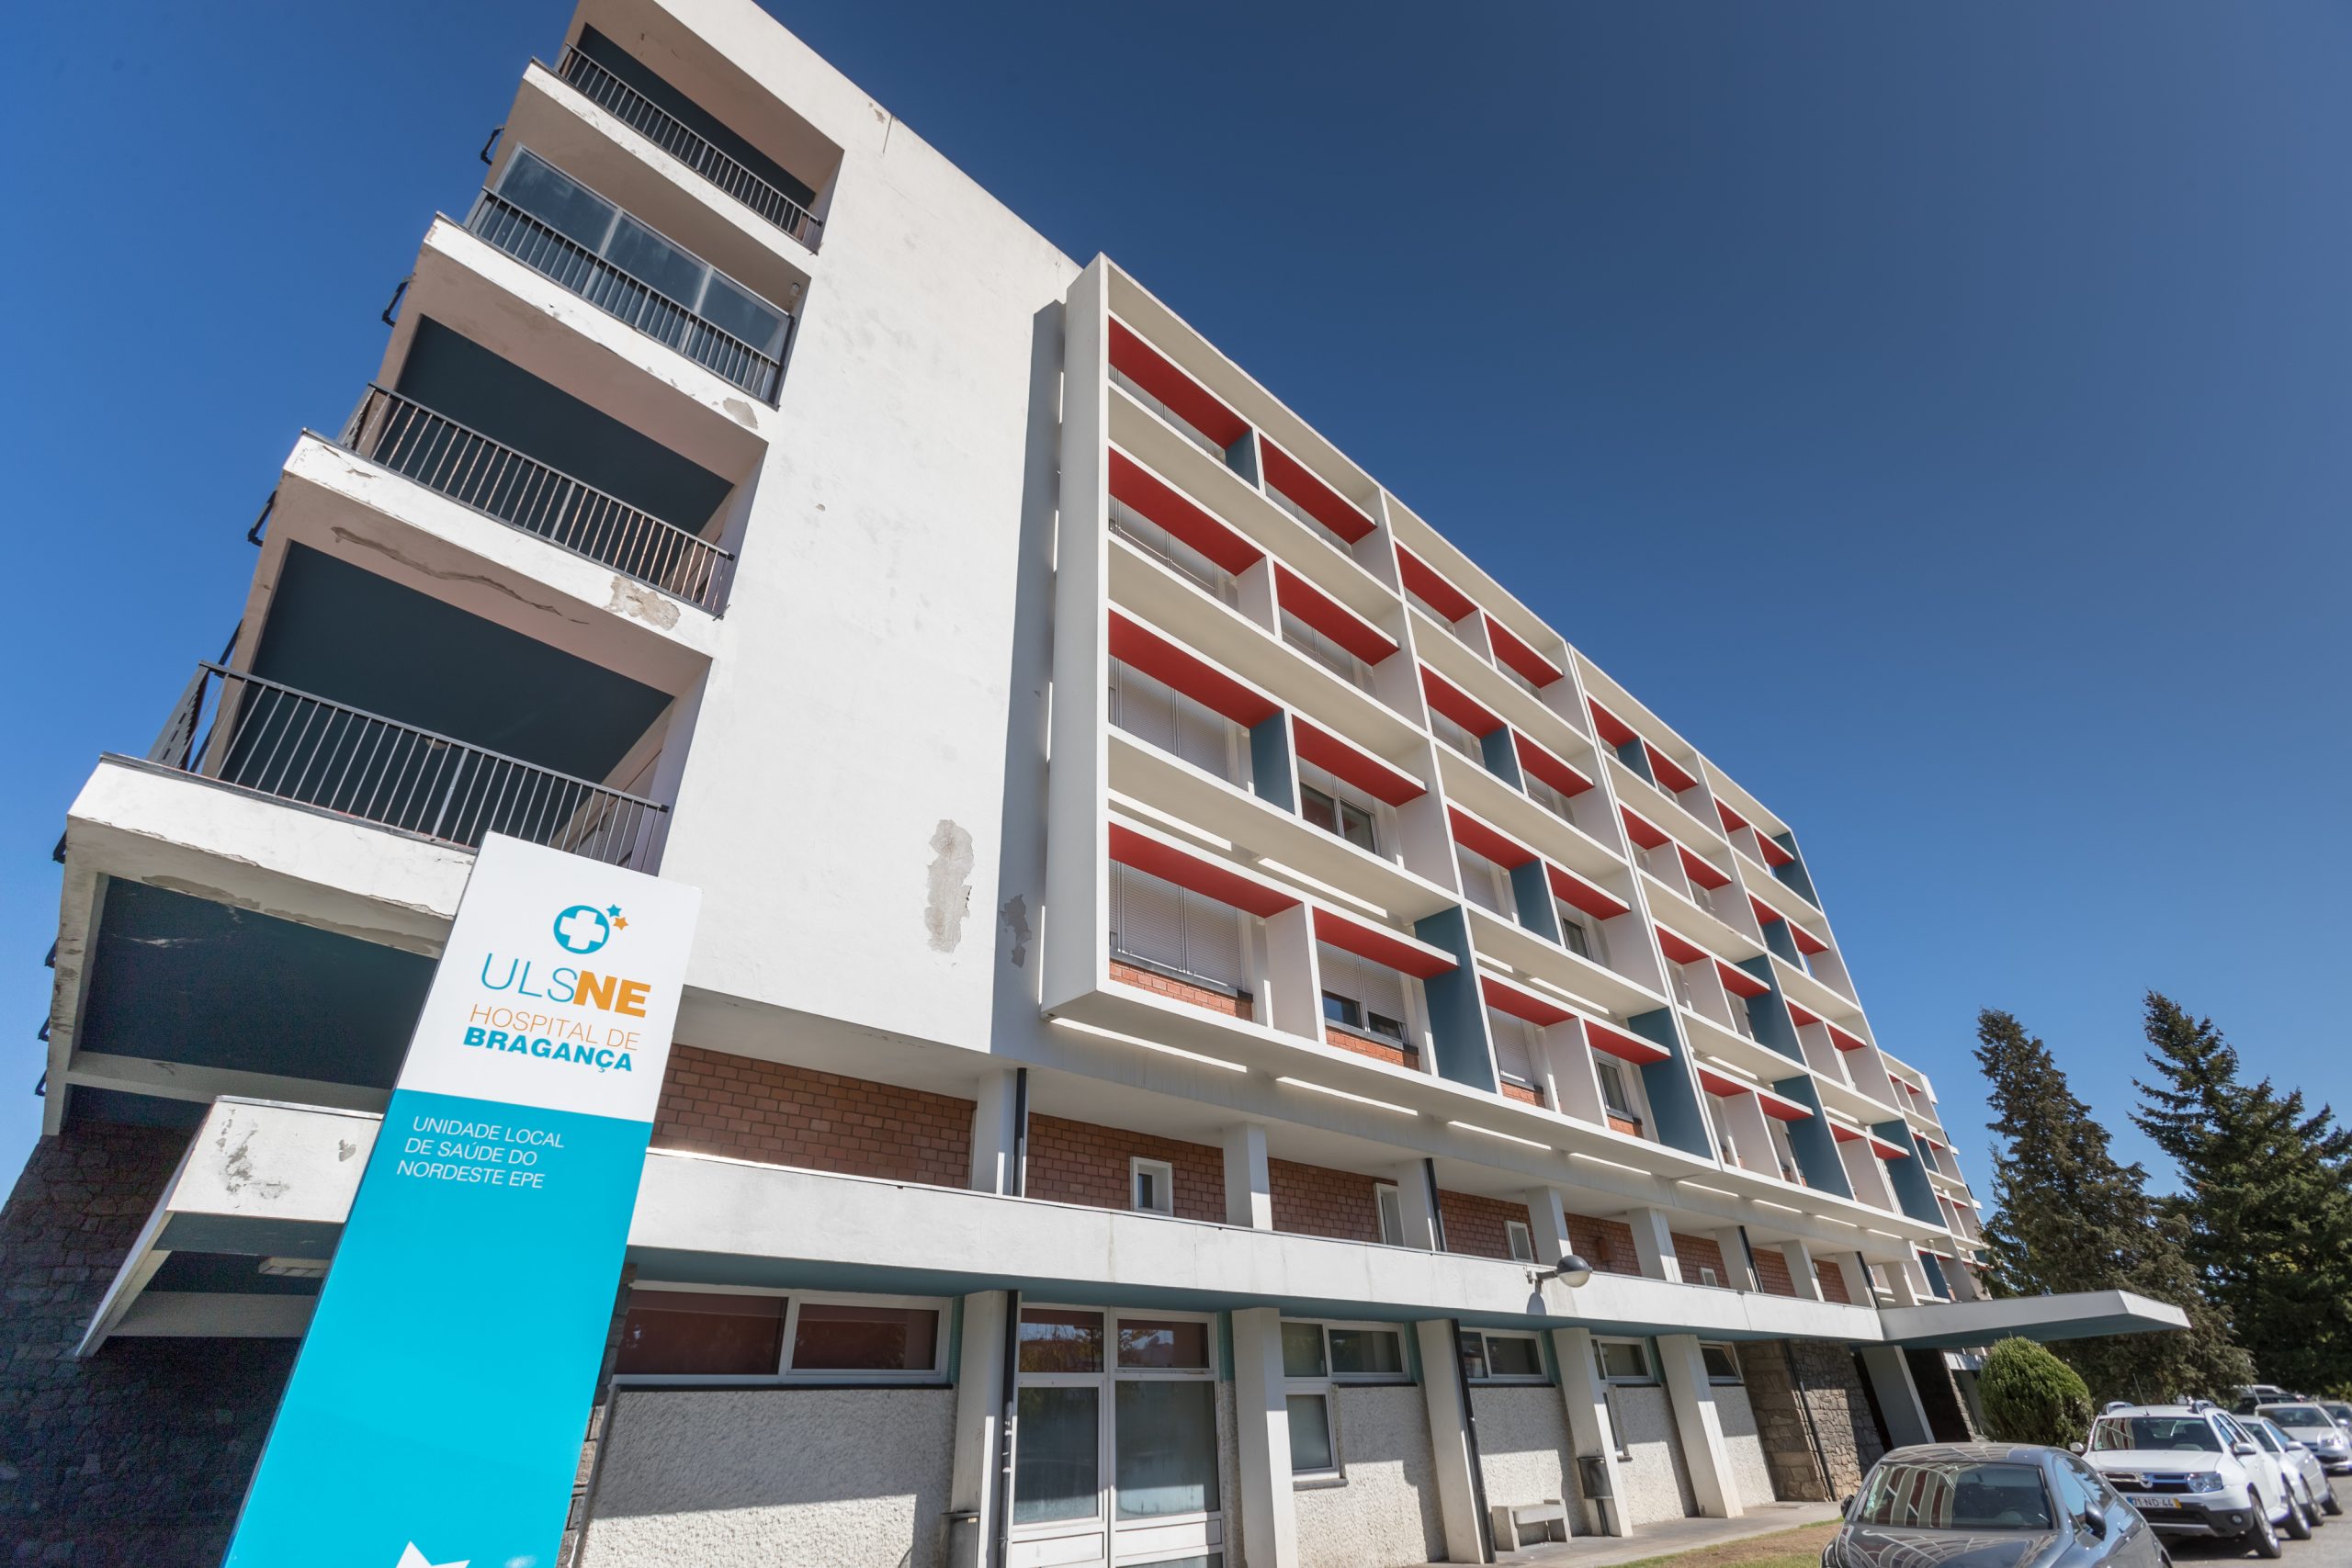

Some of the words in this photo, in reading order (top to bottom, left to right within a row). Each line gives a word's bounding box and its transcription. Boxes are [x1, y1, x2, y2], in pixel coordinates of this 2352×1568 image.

[481, 953, 651, 1018] ULSNE
[469, 1003, 598, 1043] HOSPITAL
[606, 1028, 641, 1051] DE
[463, 1026, 632, 1073] BRAGANÇA
[404, 1137, 435, 1156] DE
[437, 1141, 505, 1163] SAÚDE
[508, 1149, 537, 1166] DO
[413, 1116, 502, 1141] UNIDADE
[505, 1127, 565, 1148] LOCAL
[396, 1159, 505, 1185] NORDESTE
[508, 1171, 546, 1189] EPE
